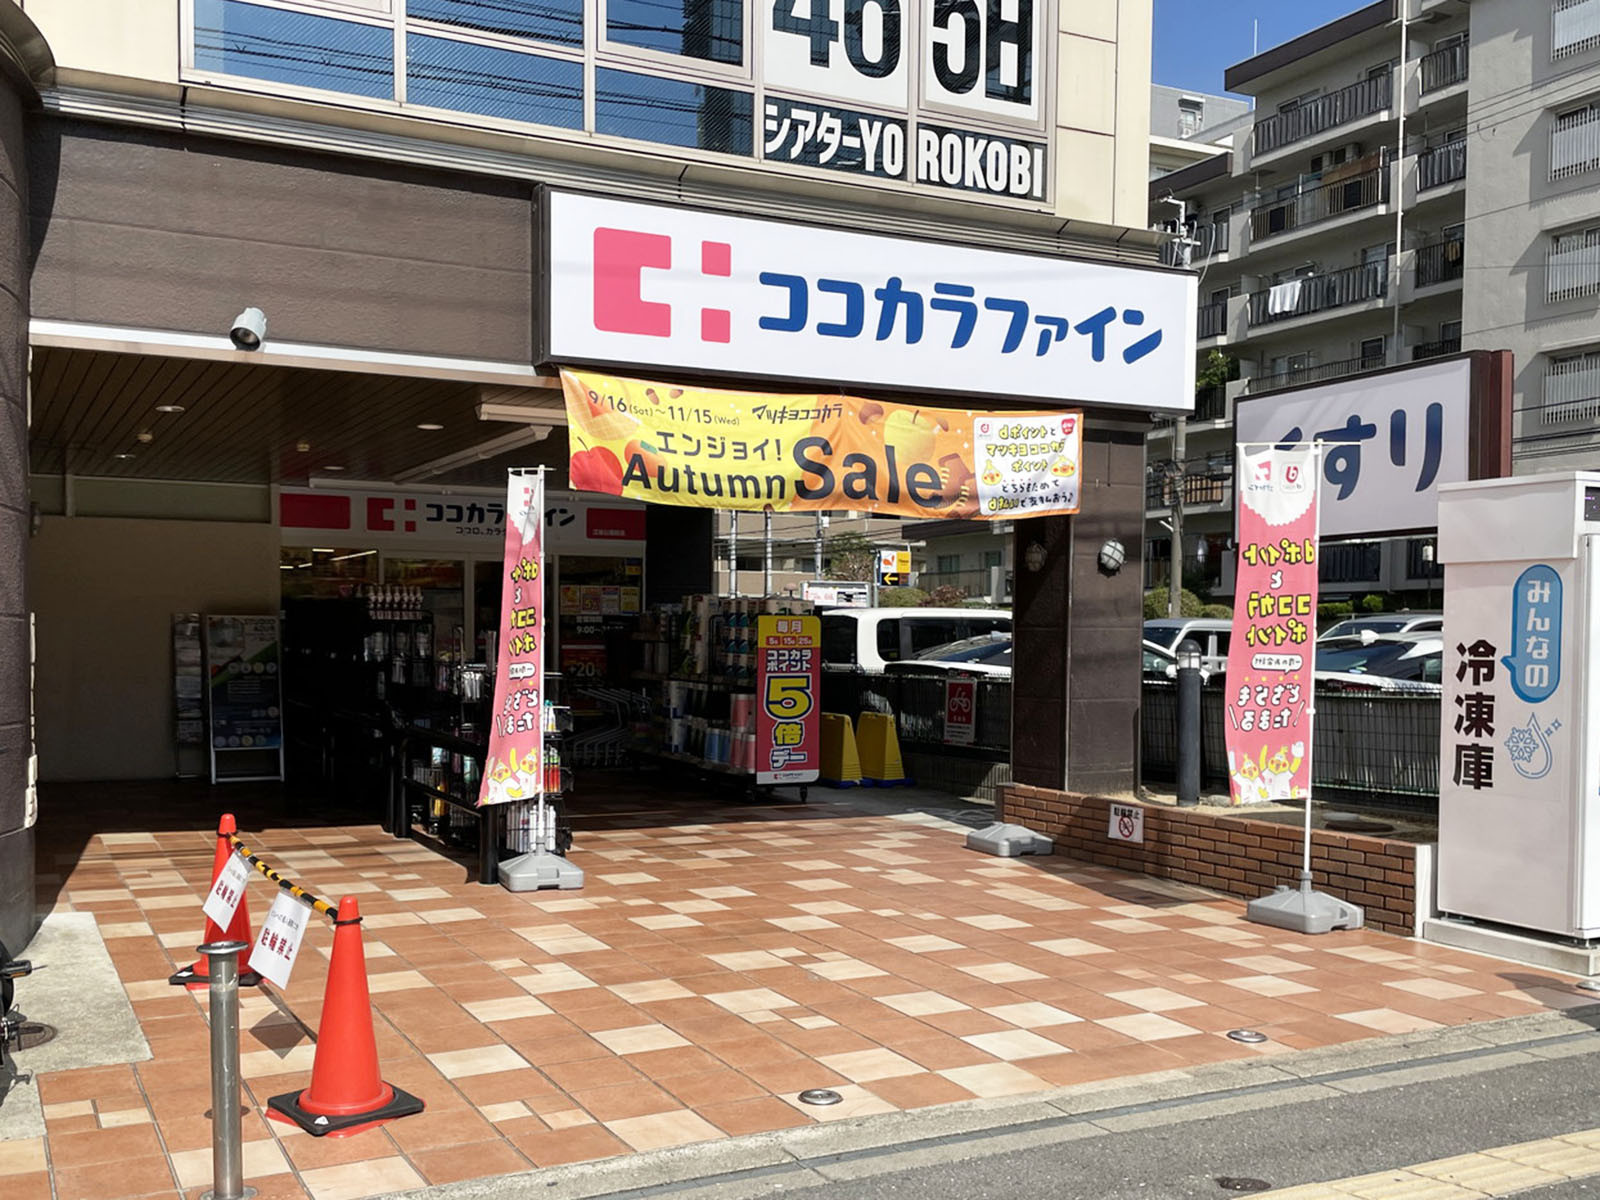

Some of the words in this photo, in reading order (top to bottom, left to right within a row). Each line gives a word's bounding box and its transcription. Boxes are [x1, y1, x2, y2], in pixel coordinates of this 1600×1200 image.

[757, 271, 1163, 365] ココカラファイン
[751, 402, 843, 425] マツキヨココカラ
[655, 430, 783, 462] エンジョイ!
[621, 452, 787, 500] Autumn
[792, 436, 943, 509] Sale
[1011, 458, 1048, 474] ポイント
[425, 502, 576, 527] ココカライン
[776, 619, 803, 634] 毎月
[1524, 579, 1551, 688] みんなの
[766, 660, 812, 673] ポイント
[767, 649, 812, 661] ココカラ
[766, 675, 813, 720] 5
[1452, 638, 1497, 791] 冷凍庫
[774, 722, 804, 747] 倍
[771, 748, 808, 770] デー
